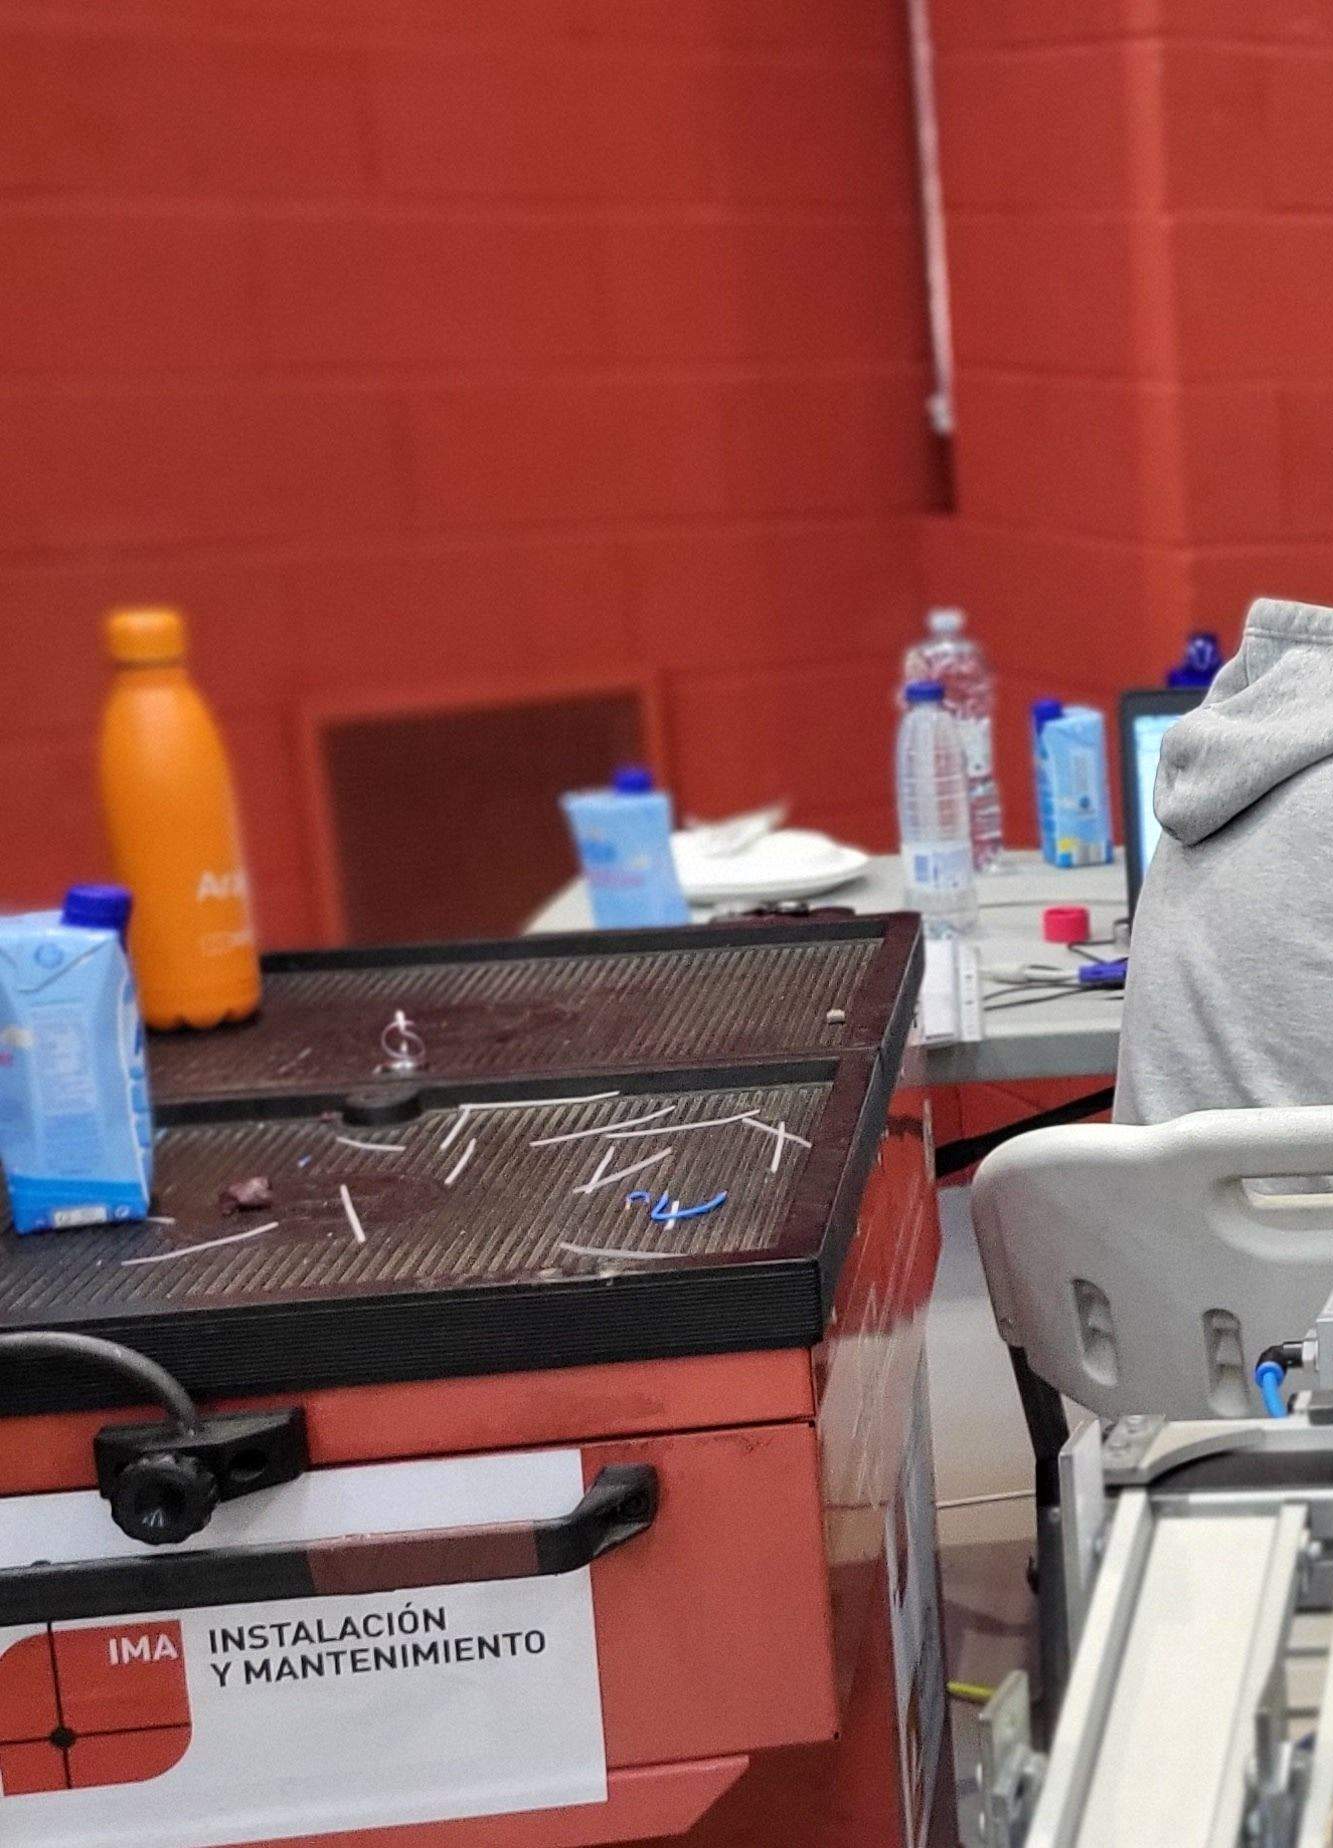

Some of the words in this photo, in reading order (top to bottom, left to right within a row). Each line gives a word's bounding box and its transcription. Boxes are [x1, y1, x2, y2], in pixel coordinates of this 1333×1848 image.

[109, 1633, 178, 1666] IMA
[208, 1602, 447, 1655] INSTALACIÓN
[210, 1661, 232, 1688] Y
[244, 1629, 546, 1686] MANTENIMIENTO
